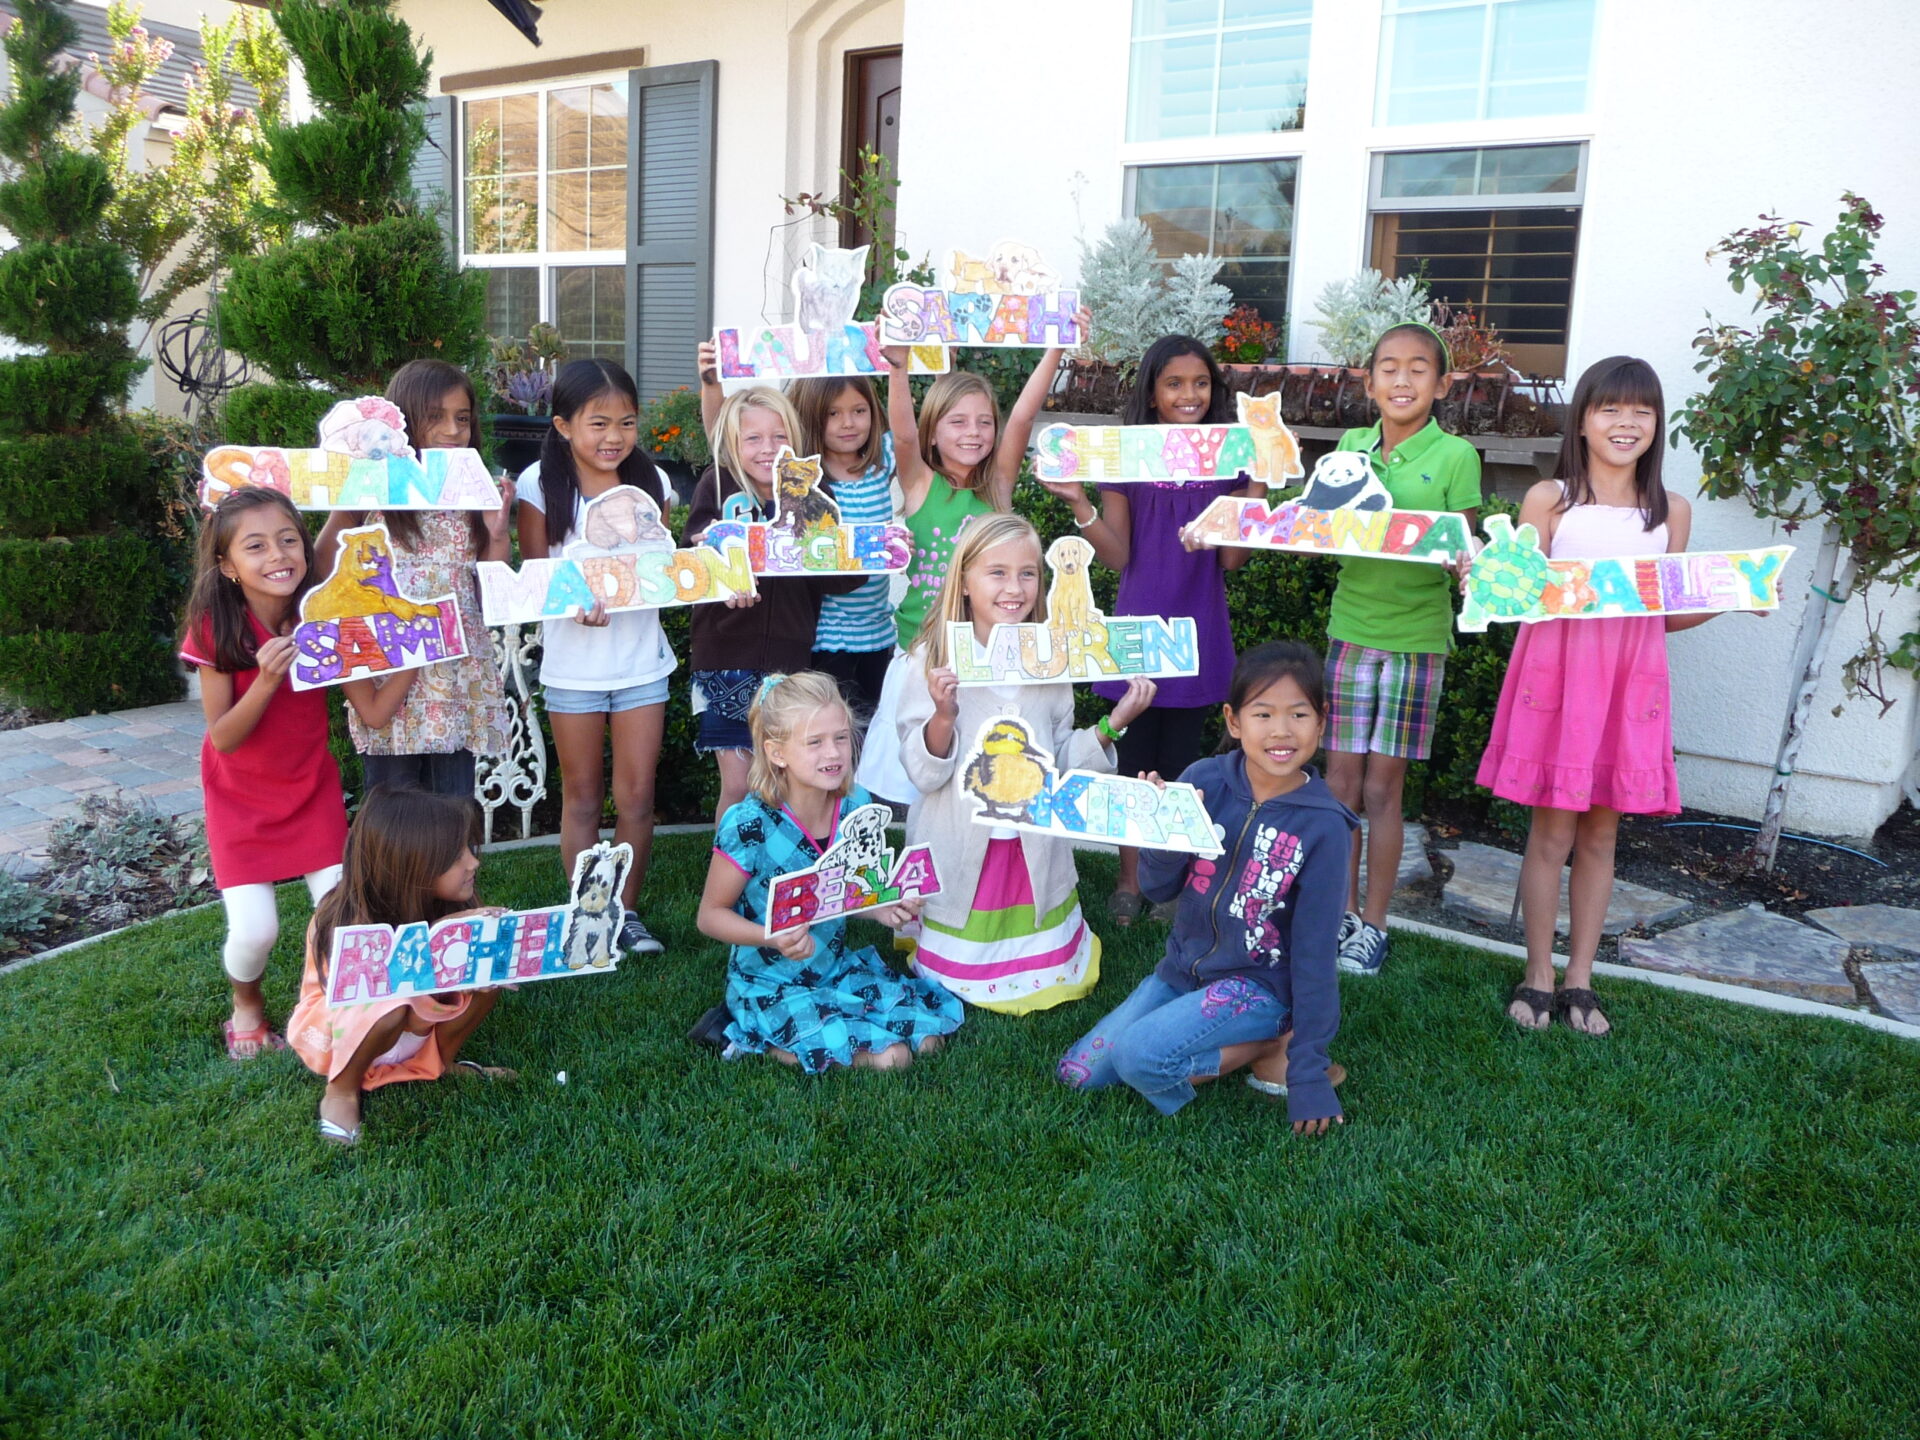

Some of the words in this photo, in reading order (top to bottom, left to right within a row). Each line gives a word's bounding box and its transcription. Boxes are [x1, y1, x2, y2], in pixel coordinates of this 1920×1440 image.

[884, 286, 1076, 343] SARAH
[208, 449, 502, 505] SAHANA
[1042, 427, 1256, 478] SHRAYA
[1197, 500, 1467, 563] AMANDA
[1540, 550, 1789, 615] BAILEY
[295, 599, 464, 684] SAMI
[954, 620, 1195, 681] LAUREN
[1027, 771, 1219, 849] KIRA
[771, 848, 941, 933] BELLA
[331, 911, 569, 1003] RACHEL
